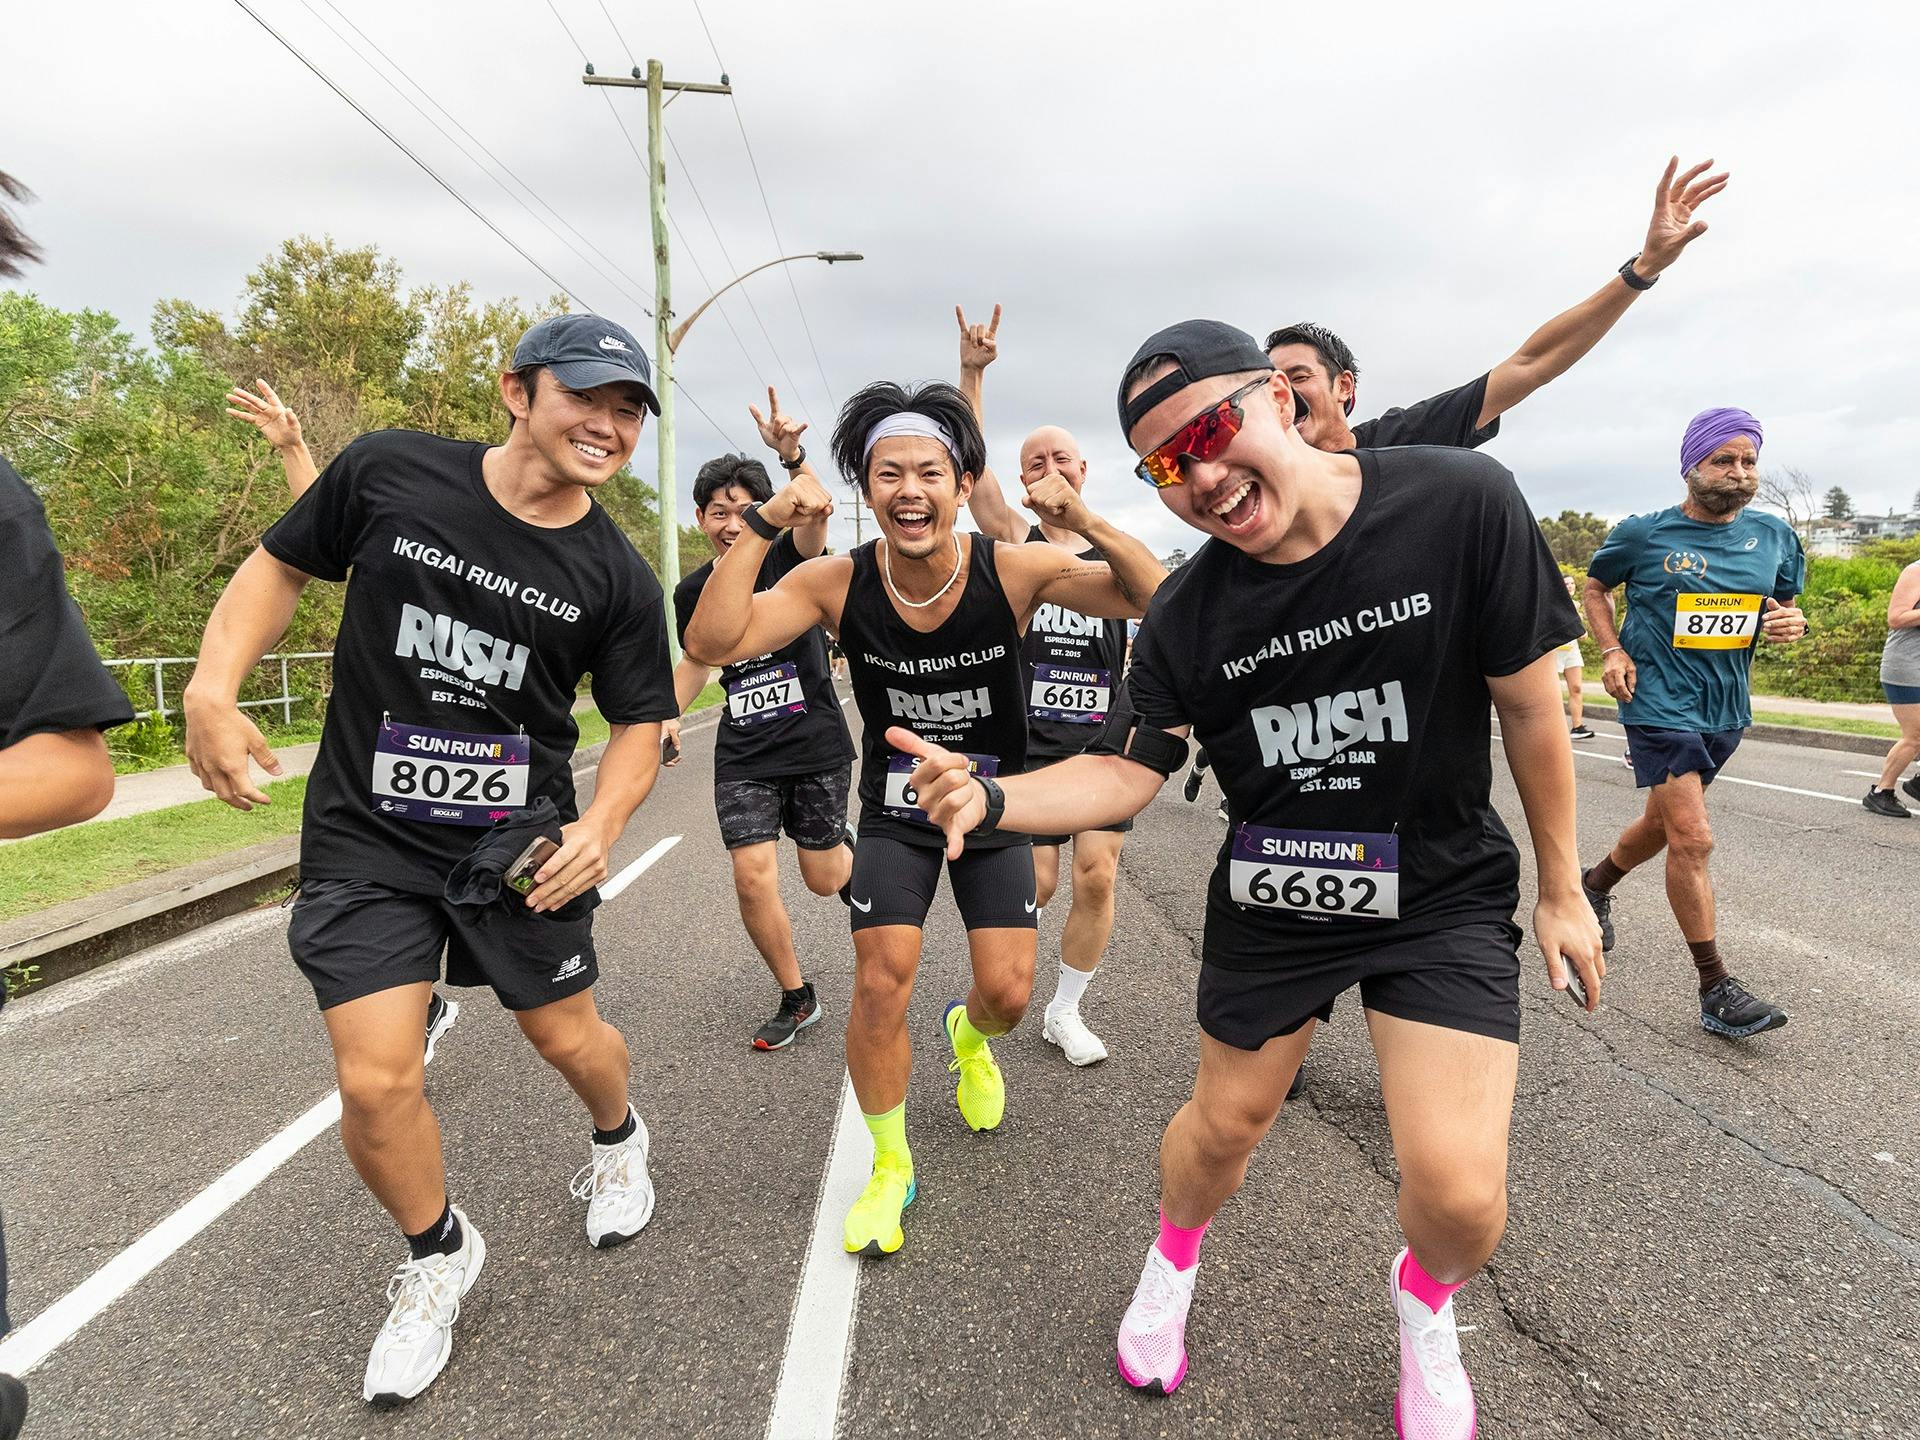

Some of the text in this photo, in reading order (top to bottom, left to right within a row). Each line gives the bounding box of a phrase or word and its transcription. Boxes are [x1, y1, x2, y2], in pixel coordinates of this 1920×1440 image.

[604, 335, 626, 348] NIKE
[393, 536, 581, 623] IKIGAI RUN CLUB
[1695, 597, 1742, 606] SUN RUN
[1298, 617, 1353, 652] RUN
[1356, 591, 1433, 633] CLUB
[1687, 614, 1749, 635] 8787
[395, 603, 530, 691] RUSH
[1044, 635, 1090, 647] ESPRESSO BAR
[1050, 648, 1082, 658] EST. 2015
[863, 644, 1006, 675] IKIGAI RUN CLUB
[420, 667, 474, 692] ESPRESSO
[741, 675, 760, 688] SUN
[760, 669, 780, 683] RUN
[1049, 669, 1072, 681] SUN
[1072, 672, 1093, 683] RUN
[431, 690, 487, 710] EST. 2015
[738, 683, 790, 714] 7047
[886, 686, 993, 723] RUSH
[1043, 685, 1098, 710] 6613
[912, 721, 973, 731] ESPRESSO BAR
[1251, 680, 1409, 768] RUSH
[407, 734, 450, 753] SUN
[451, 739, 494, 758] RUN
[923, 733, 964, 742] EST. 2015
[1348, 751, 1376, 764] BAR
[390, 760, 510, 803] 8026
[1299, 777, 1362, 792] EST. 2015
[1261, 837, 1365, 862] SUN RUN 2025
[1248, 868, 1380, 916] 6682
